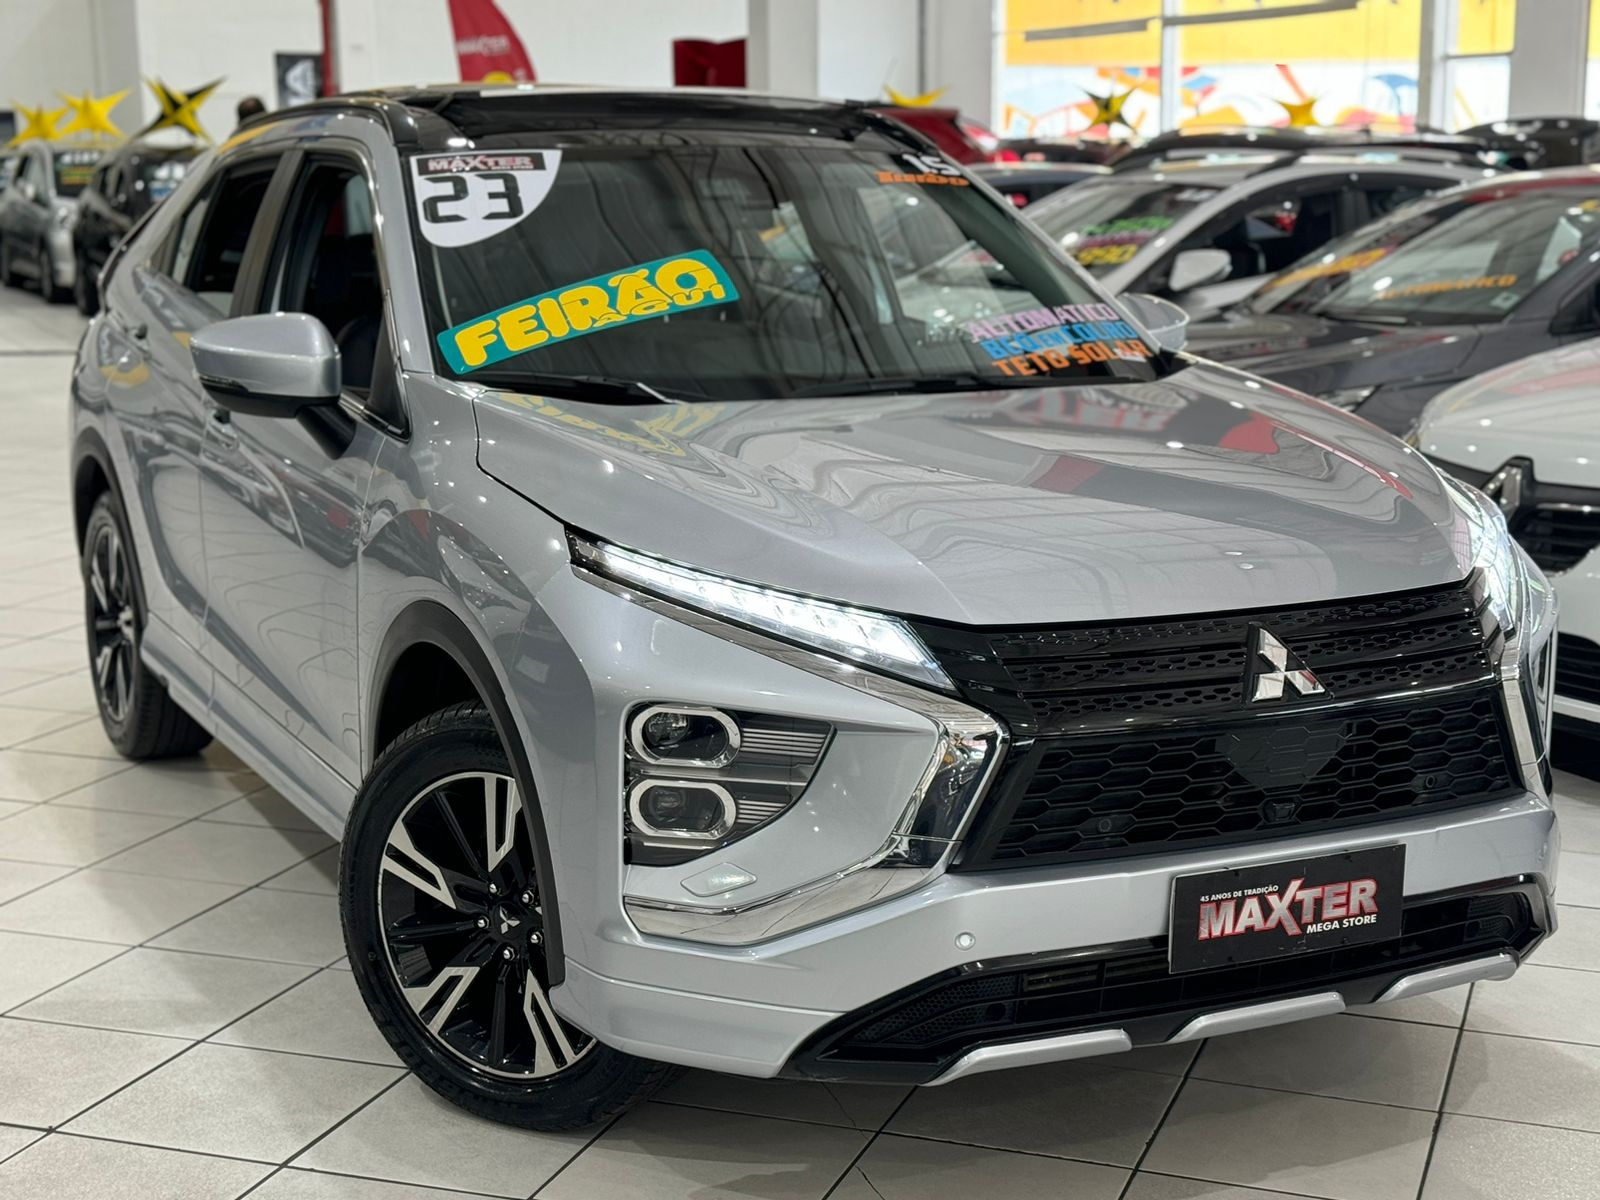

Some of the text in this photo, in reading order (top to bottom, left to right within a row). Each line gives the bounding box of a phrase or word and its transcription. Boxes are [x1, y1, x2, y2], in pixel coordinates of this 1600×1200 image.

[427, 156, 533, 171] MAXTER
[423, 172, 524, 223] 23
[454, 258, 717, 366] FEIRÃO
[966, 303, 1119, 343] AUTOMATICO
[1060, 320, 1138, 345] COURO
[992, 339, 1154, 376] TETO SOLAR
[1198, 877, 1378, 940] MAXTER
[1211, 891, 1232, 901] ANOS
[1233, 889, 1243, 898] DE
[1244, 884, 1279, 896] TRADIÇÃO
[1306, 914, 1377, 934] MEGA STORE
